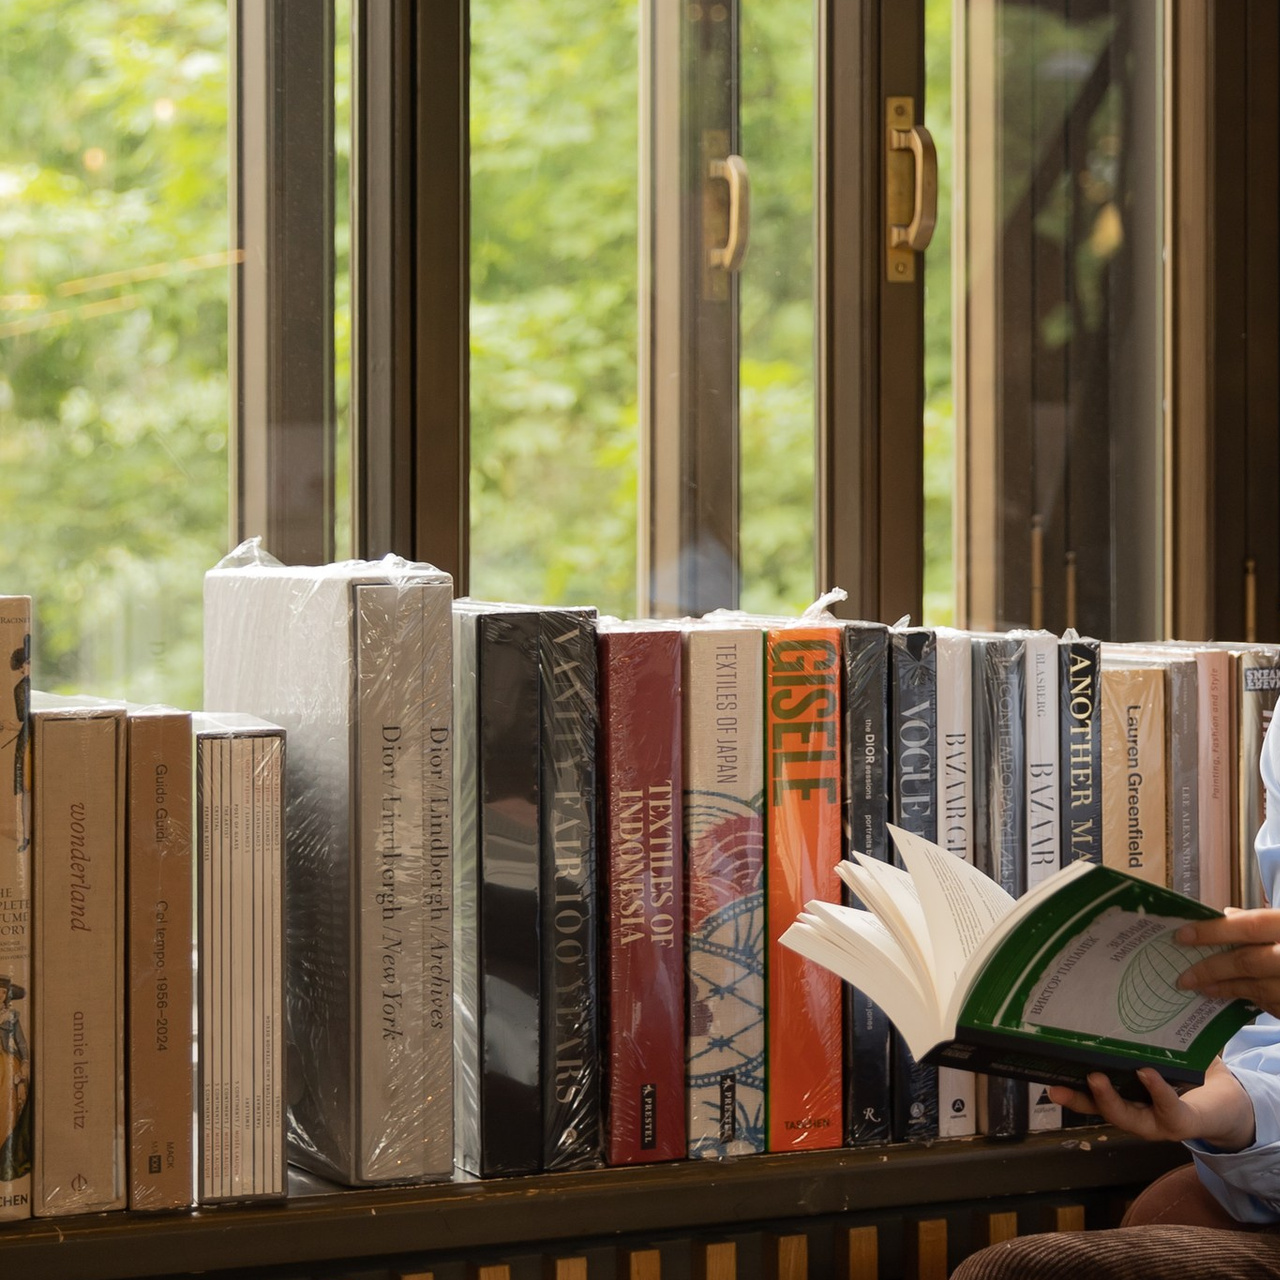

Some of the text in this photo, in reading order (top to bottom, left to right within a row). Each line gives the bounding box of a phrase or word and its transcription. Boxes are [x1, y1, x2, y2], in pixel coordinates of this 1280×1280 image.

[553, 627, 580, 771] VANITY
[716, 644, 738, 784] TEXTILES OF JAPAN
[772, 639, 837, 806] GISELE
[1035, 653, 1047, 718] BLASBERG
[381, 725, 402, 779] Dior
[429, 726, 450, 779] Dior
[864, 719, 875, 799] the DIOR sessions
[899, 700, 931, 818] VOGUE
[945, 733, 966, 820] BAZAAR
[1069, 654, 1092, 864] ANOTHER MA
[1210, 668, 1221, 799] Painting, Fashion and Style
[155, 763, 169, 843] Guido Guidi
[1030, 763, 1055, 866] BAZAAR
[1127, 705, 1143, 869] Lauren Greenfield
[1181, 786, 1190, 808] LEE
[69, 801, 91, 932] wonderland
[375, 796, 402, 921] Lindbergh
[425, 797, 449, 921] Lindbergh
[554, 788, 582, 879] FAIR
[618, 788, 645, 946] INDONESIA
[649, 780, 673, 947] TEXTILES OF
[1181, 810, 1190, 879] ALEXANDER
[151, 926, 168, 972] tempo,
[155, 900, 169, 924] Col
[1110, 922, 1168, 963] ИМПЕРАТИВ
[381, 934, 402, 987] New
[428, 934, 449, 1030] Archives
[1031, 933, 1101, 1016] ВИКТОР ПАПАНЕК
[381, 989, 402, 1041] York
[554, 982, 582, 1104] YEARS
[864, 1007, 874, 1032] jones
[72, 1011, 88, 1130] annie leibovitz
[166, 1141, 174, 1169] MACK
[644, 1097, 654, 1144] PRESTEL
[784, 1119, 831, 1131] TASCHEN
